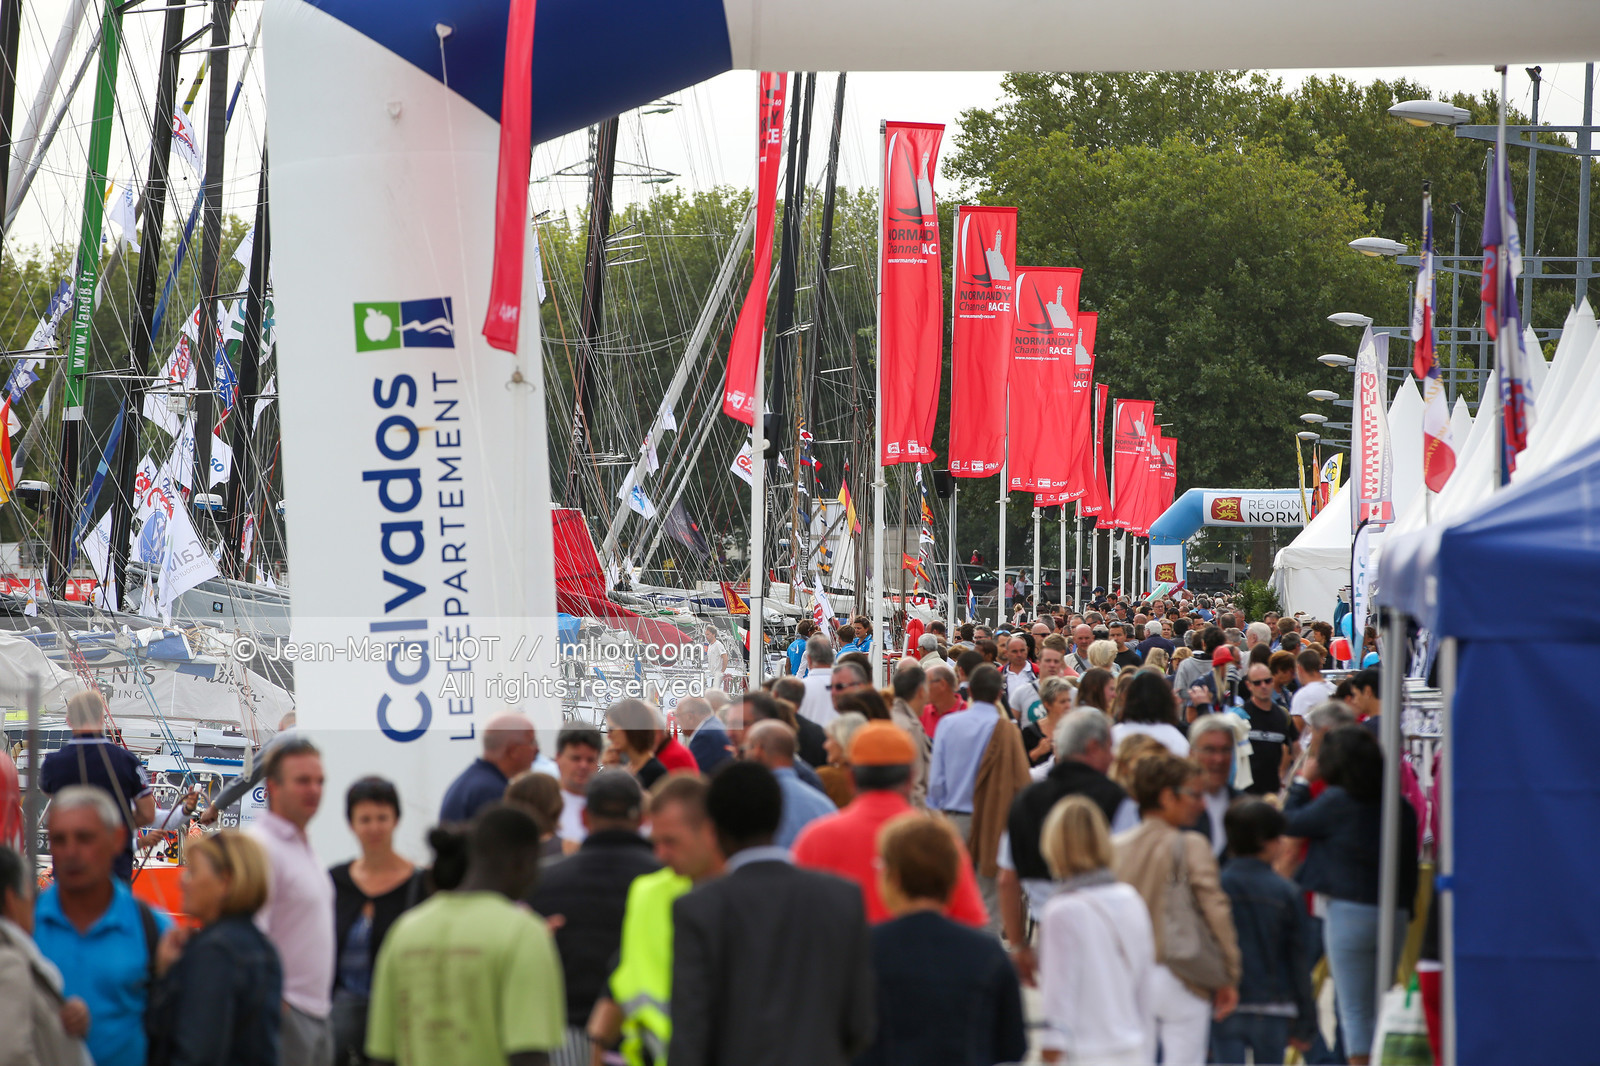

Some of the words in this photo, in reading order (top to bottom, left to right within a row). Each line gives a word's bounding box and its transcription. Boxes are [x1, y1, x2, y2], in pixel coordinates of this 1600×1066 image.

[960, 291, 1011, 301] NORMANDY
[1015, 337, 1073, 346] NORMANDY
[1014, 345, 1048, 355] Channel
[1048, 346, 1073, 356] RACE
[1361, 372, 1380, 500] WINNIPEG
[1248, 496, 1301, 510] RÉGION
[432, 371, 473, 672] DÉPARTEMENT
[1249, 511, 1303, 523] NORM
[362, 373, 433, 743] Calvados
[448, 697, 476, 741] LE
[222, 818, 238, 828] 09
